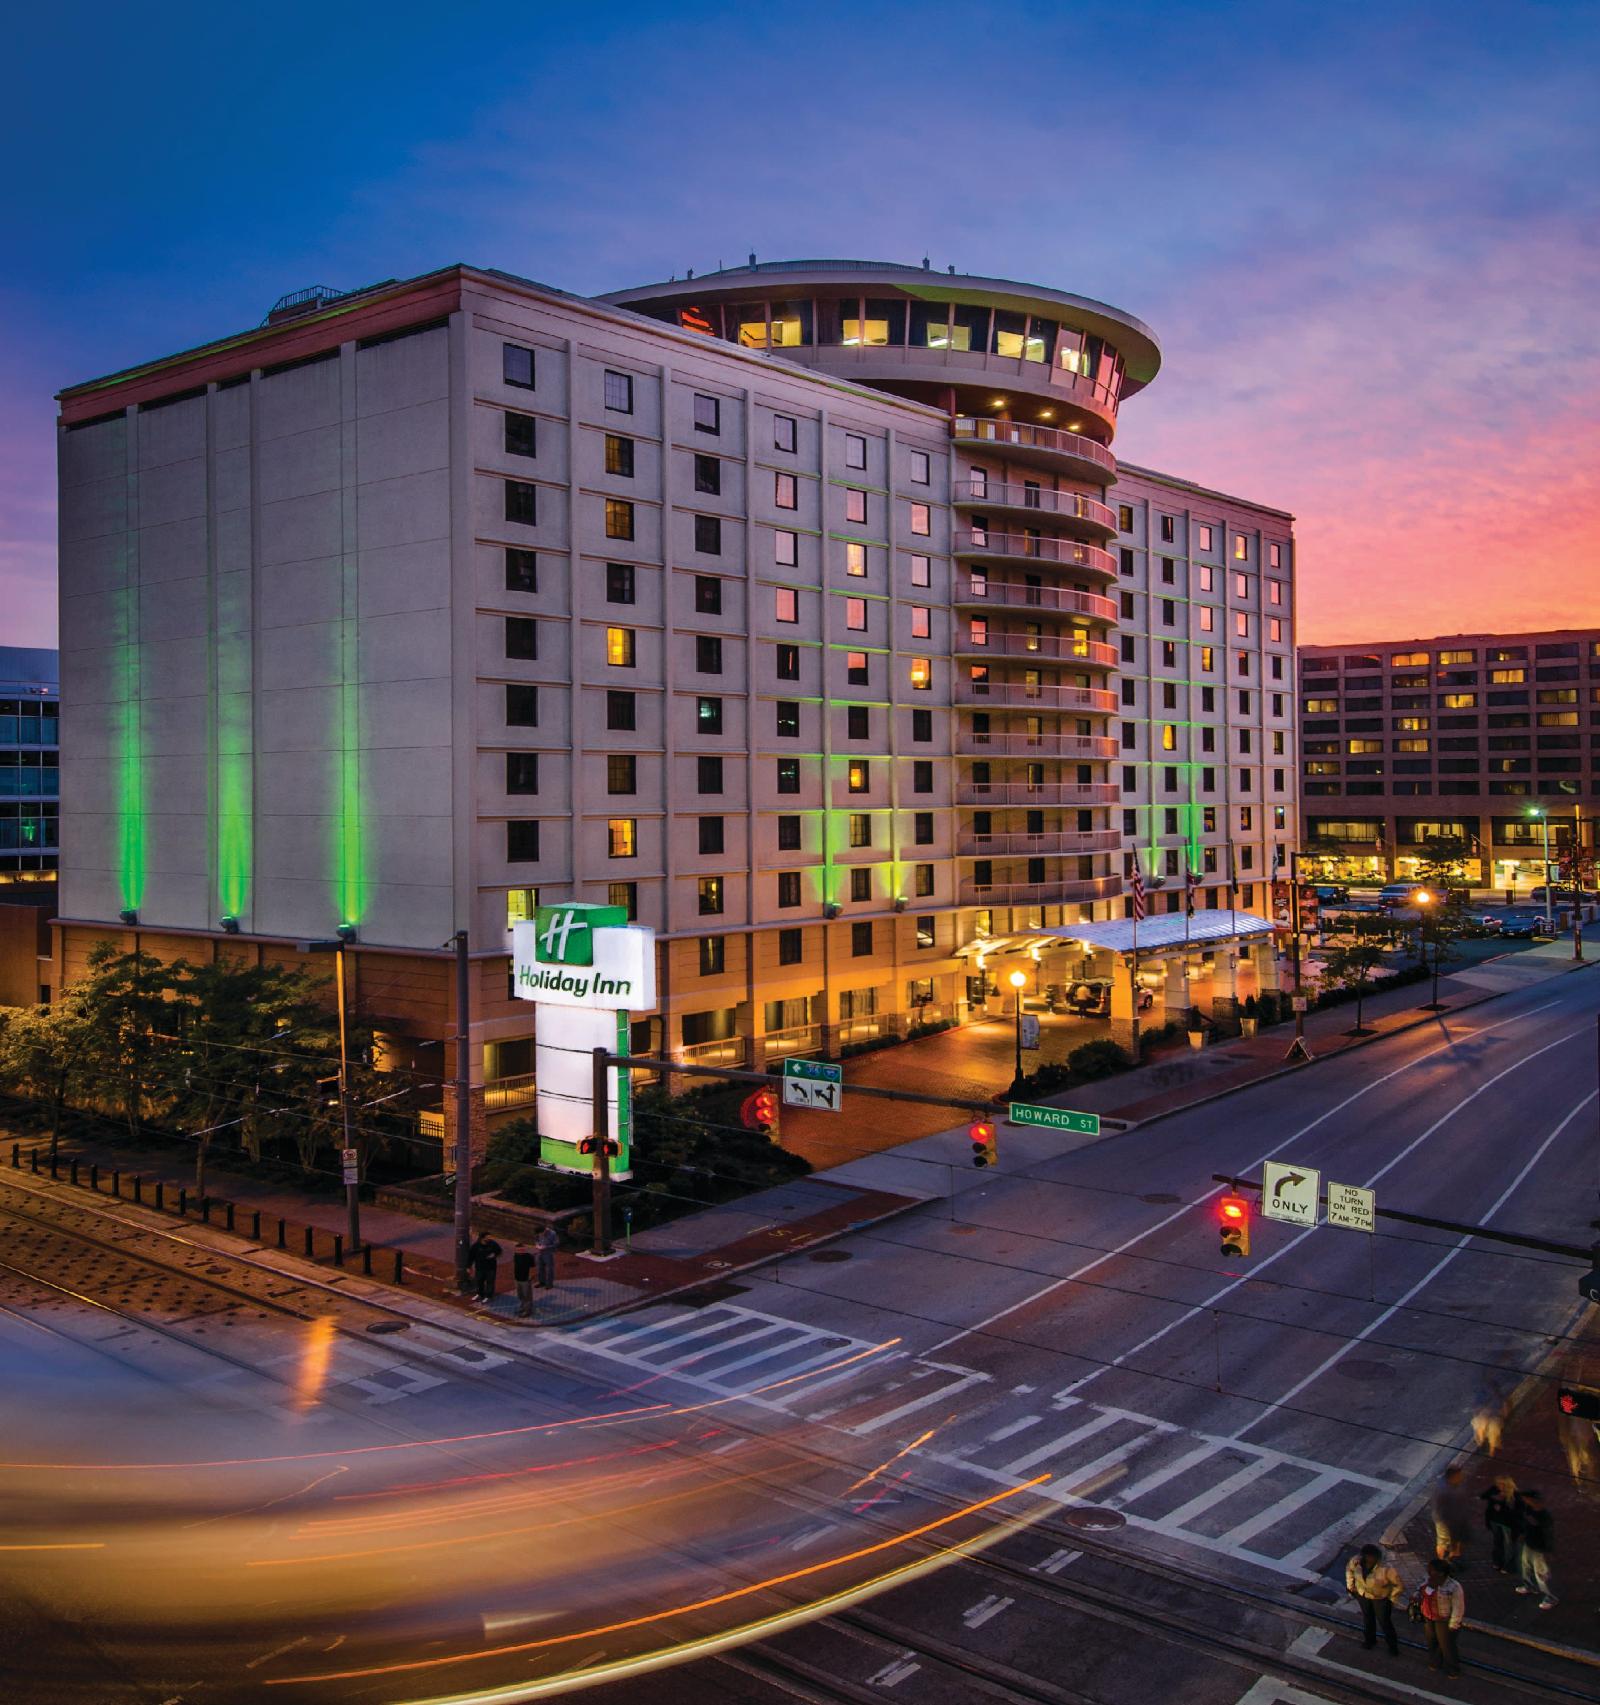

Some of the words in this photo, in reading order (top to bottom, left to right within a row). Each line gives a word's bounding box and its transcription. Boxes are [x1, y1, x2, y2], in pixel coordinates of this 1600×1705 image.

[519, 964, 588, 998] Holiday
[592, 972, 631, 995] Inn
[1015, 1108, 1070, 1125] HOWARD
[1080, 1119, 1093, 1129] ST
[1344, 1188, 1358, 1197] NO
[1272, 1198, 1309, 1214] ONLY
[1340, 1195, 1364, 1206] TURN
[1333, 1202, 1346, 1211] ON
[1351, 1206, 1370, 1216] RED
